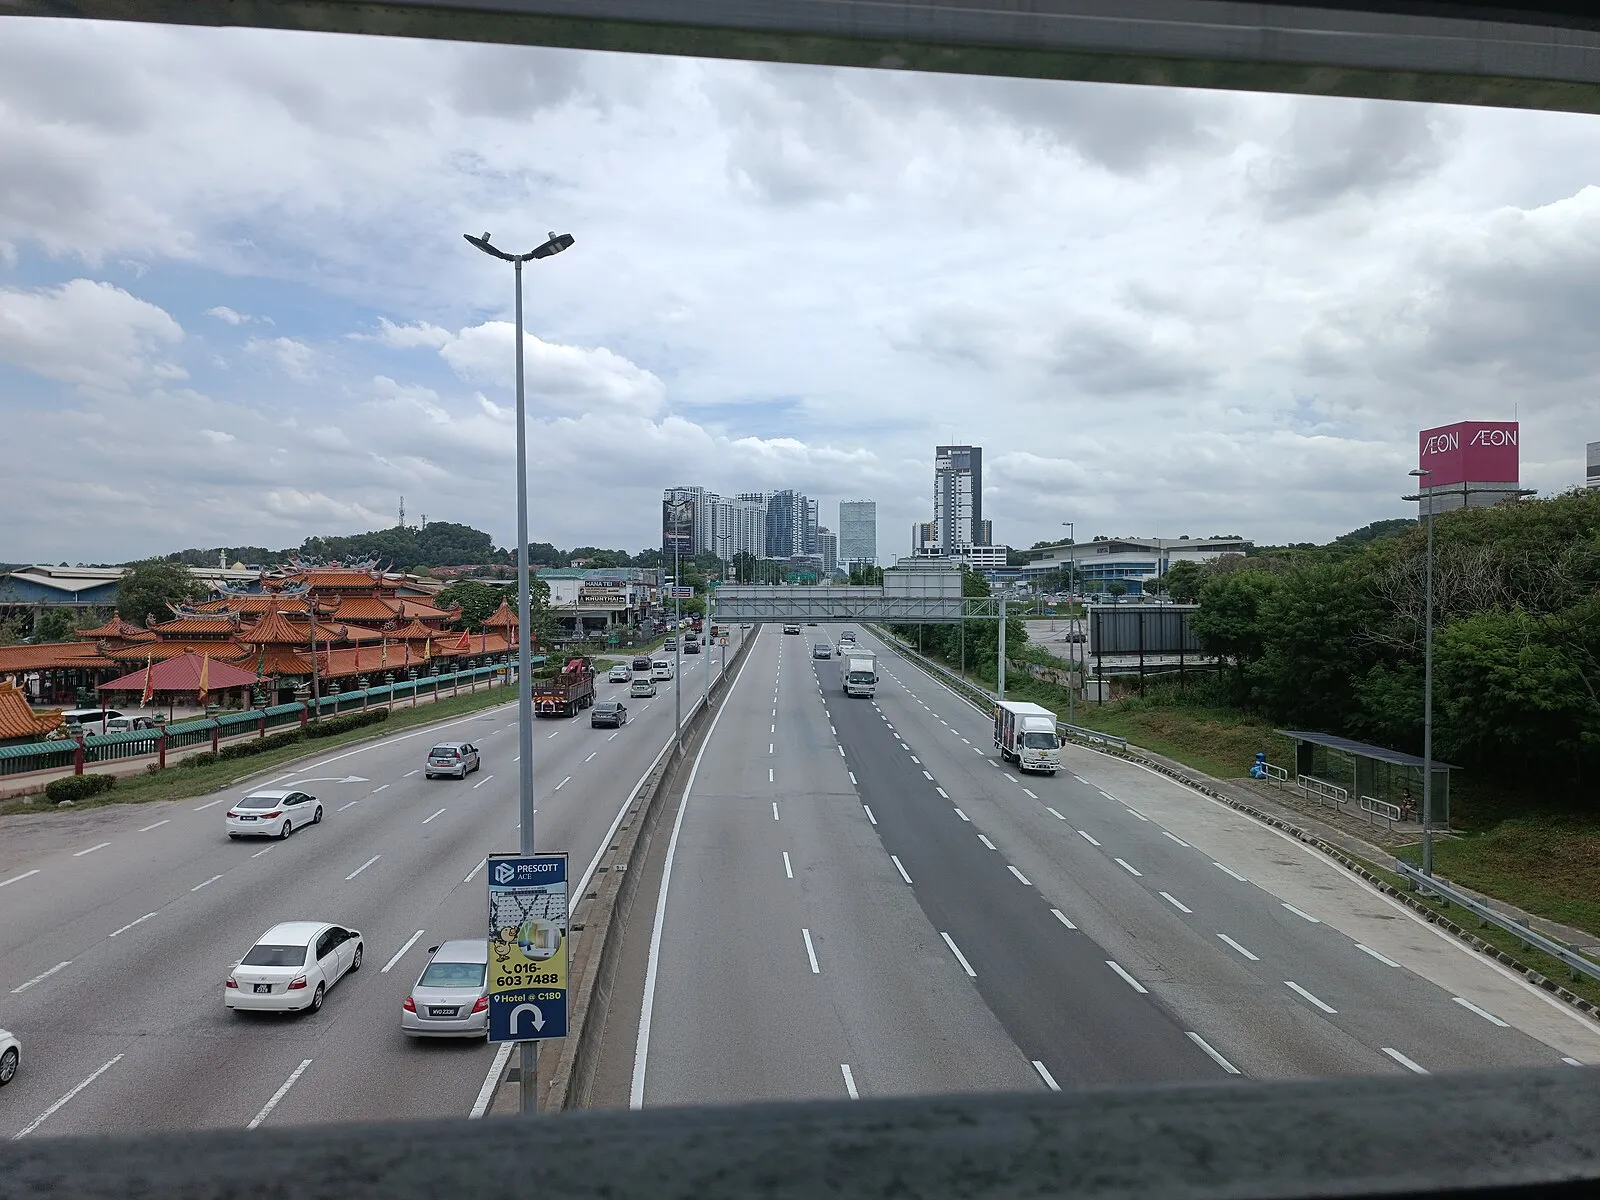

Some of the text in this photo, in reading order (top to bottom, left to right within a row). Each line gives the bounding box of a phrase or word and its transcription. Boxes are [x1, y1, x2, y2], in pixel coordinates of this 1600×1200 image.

[517, 864, 559, 873] PRESCOTT
[513, 963, 542, 974] 016-
[496, 973, 559, 987] 603 7488
[501, 994, 526, 1003] Hotel
[537, 992, 561, 1000] C180
